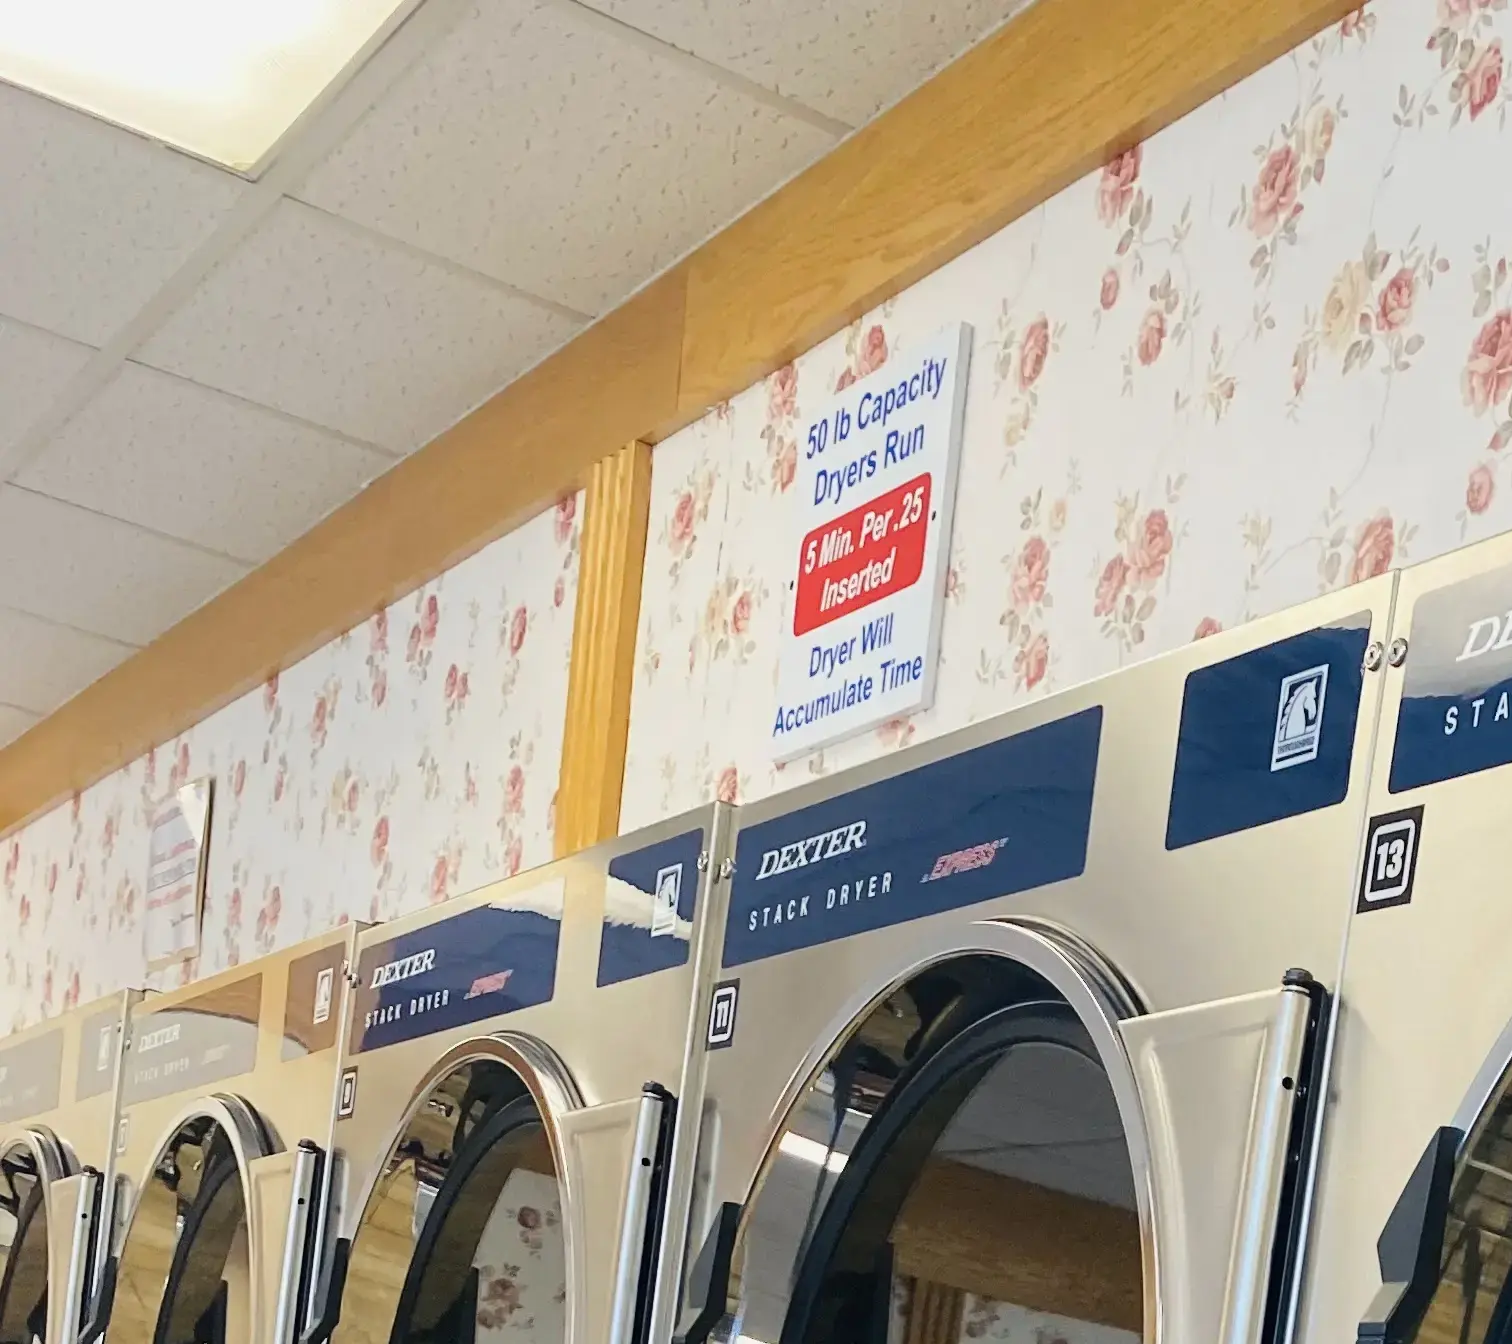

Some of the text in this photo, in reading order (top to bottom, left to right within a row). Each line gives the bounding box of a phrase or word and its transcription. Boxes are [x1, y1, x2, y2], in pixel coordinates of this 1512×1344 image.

[806, 357, 947, 459] 50 lb Capacity
[814, 424, 924, 506] Dryers Run
[804, 485, 925, 575] 5 Min. Per .25
[819, 546, 897, 612] Inserted
[809, 612, 894, 679] Dryer Will
[772, 655, 922, 737] Accumulate Time
[755, 820, 867, 880] DEXTER
[1375, 838, 1406, 881] 13
[748, 871, 892, 932] STACK DRYER
[369, 948, 436, 990] DEXTER
[364, 989, 449, 1030] STACK DRYER
